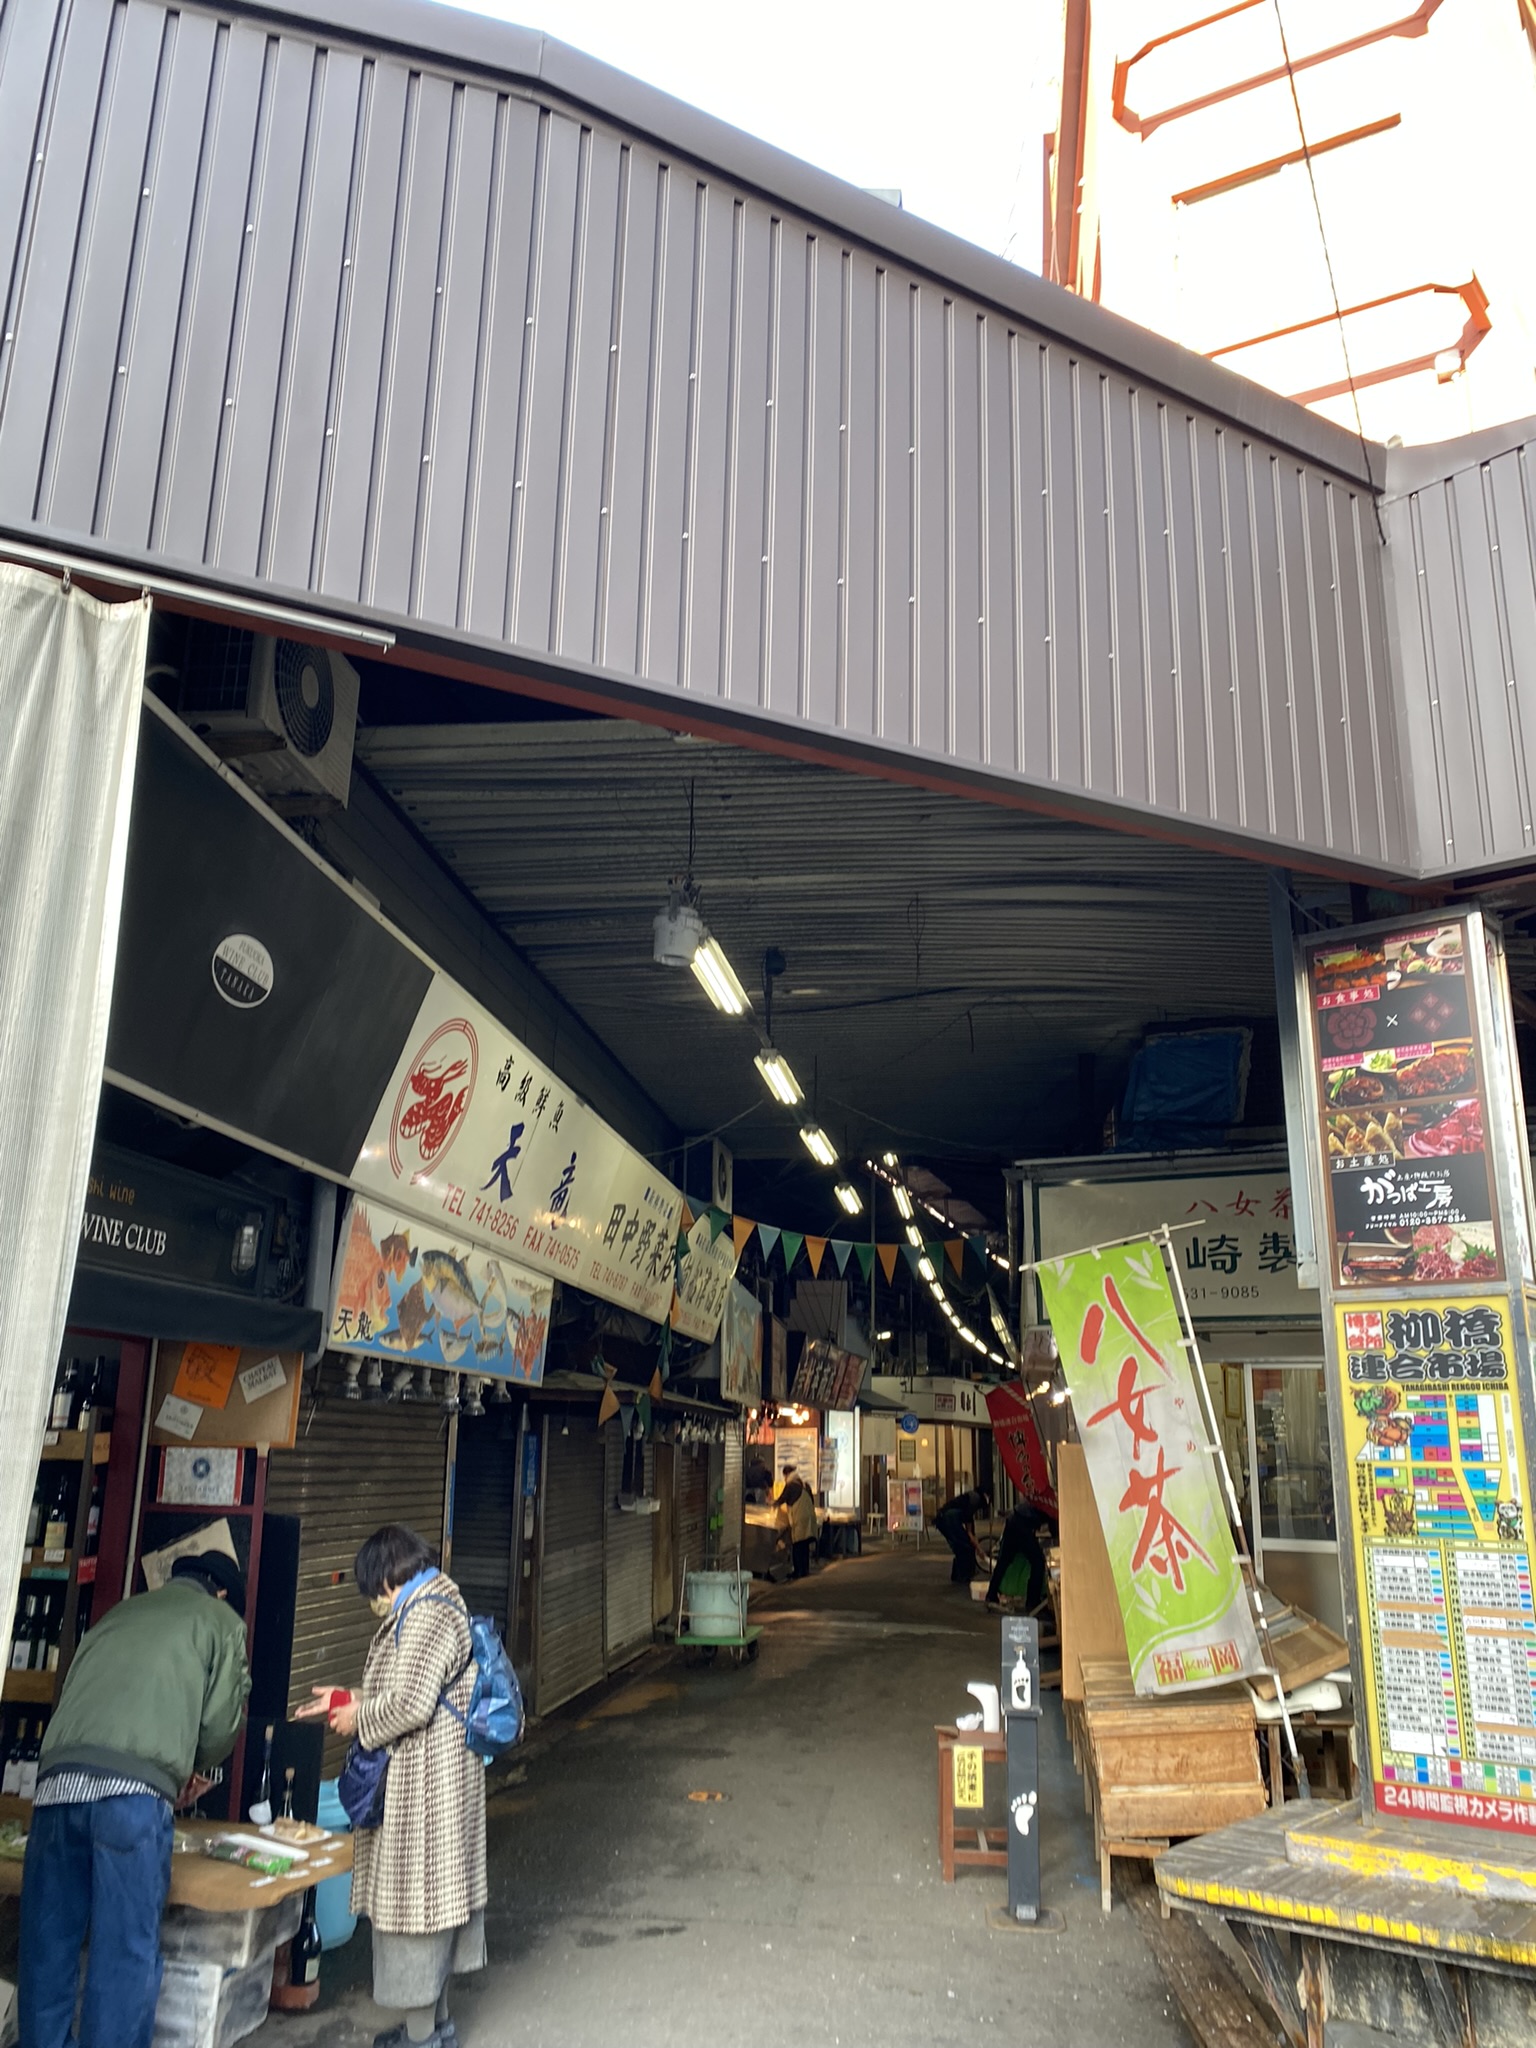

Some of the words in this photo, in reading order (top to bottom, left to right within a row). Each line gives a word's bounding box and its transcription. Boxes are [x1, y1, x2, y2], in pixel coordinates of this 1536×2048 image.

[222, 943, 246, 970] WINE
[247, 962, 270, 986] CLUB
[1322, 989, 1375, 1006] お食事処
[496, 1054, 565, 1134] 高級鮮魚
[124, 1222, 167, 1256] CLUB
[442, 1183, 467, 1217] TEL
[468, 1196, 521, 1241] 741-8256
[522, 1224, 545, 1255] FAX
[543, 1234, 582, 1271] 741-0575
[1387, 1308, 1502, 1350] 柳橋
[1349, 1351, 1507, 1381] 連合市場
[1079, 1275, 1218, 1592] 八女茶
